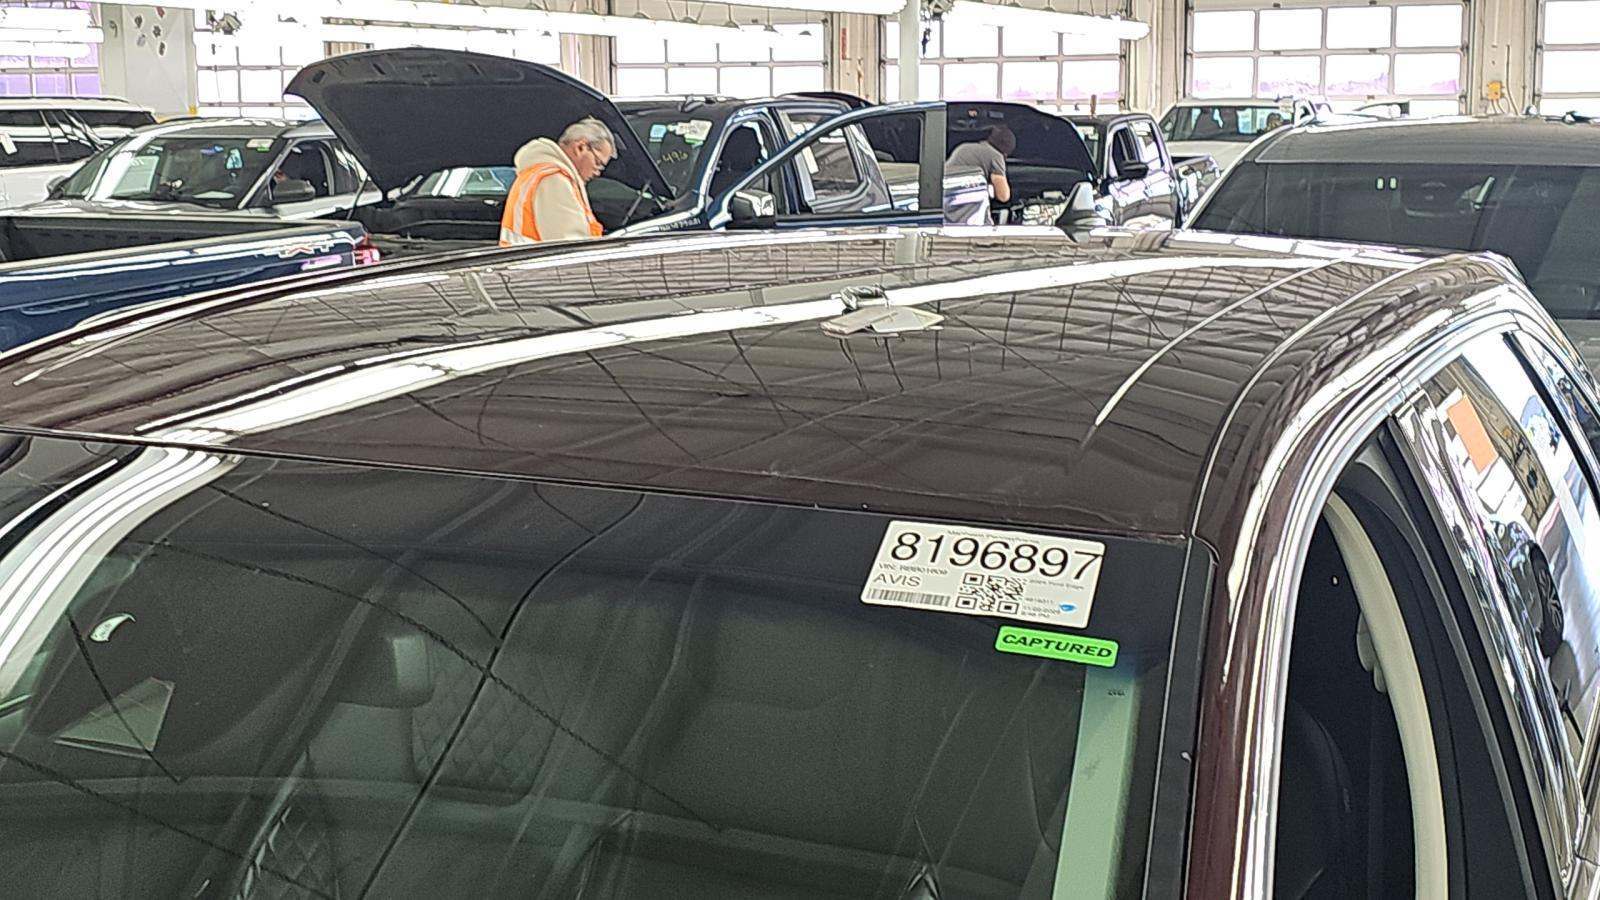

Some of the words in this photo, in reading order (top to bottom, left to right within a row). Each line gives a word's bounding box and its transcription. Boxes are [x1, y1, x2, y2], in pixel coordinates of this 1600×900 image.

[891, 532, 1103, 580] 8196897
[873, 573, 921, 587] AVIS
[1002, 634, 1113, 658] CAPTURED
